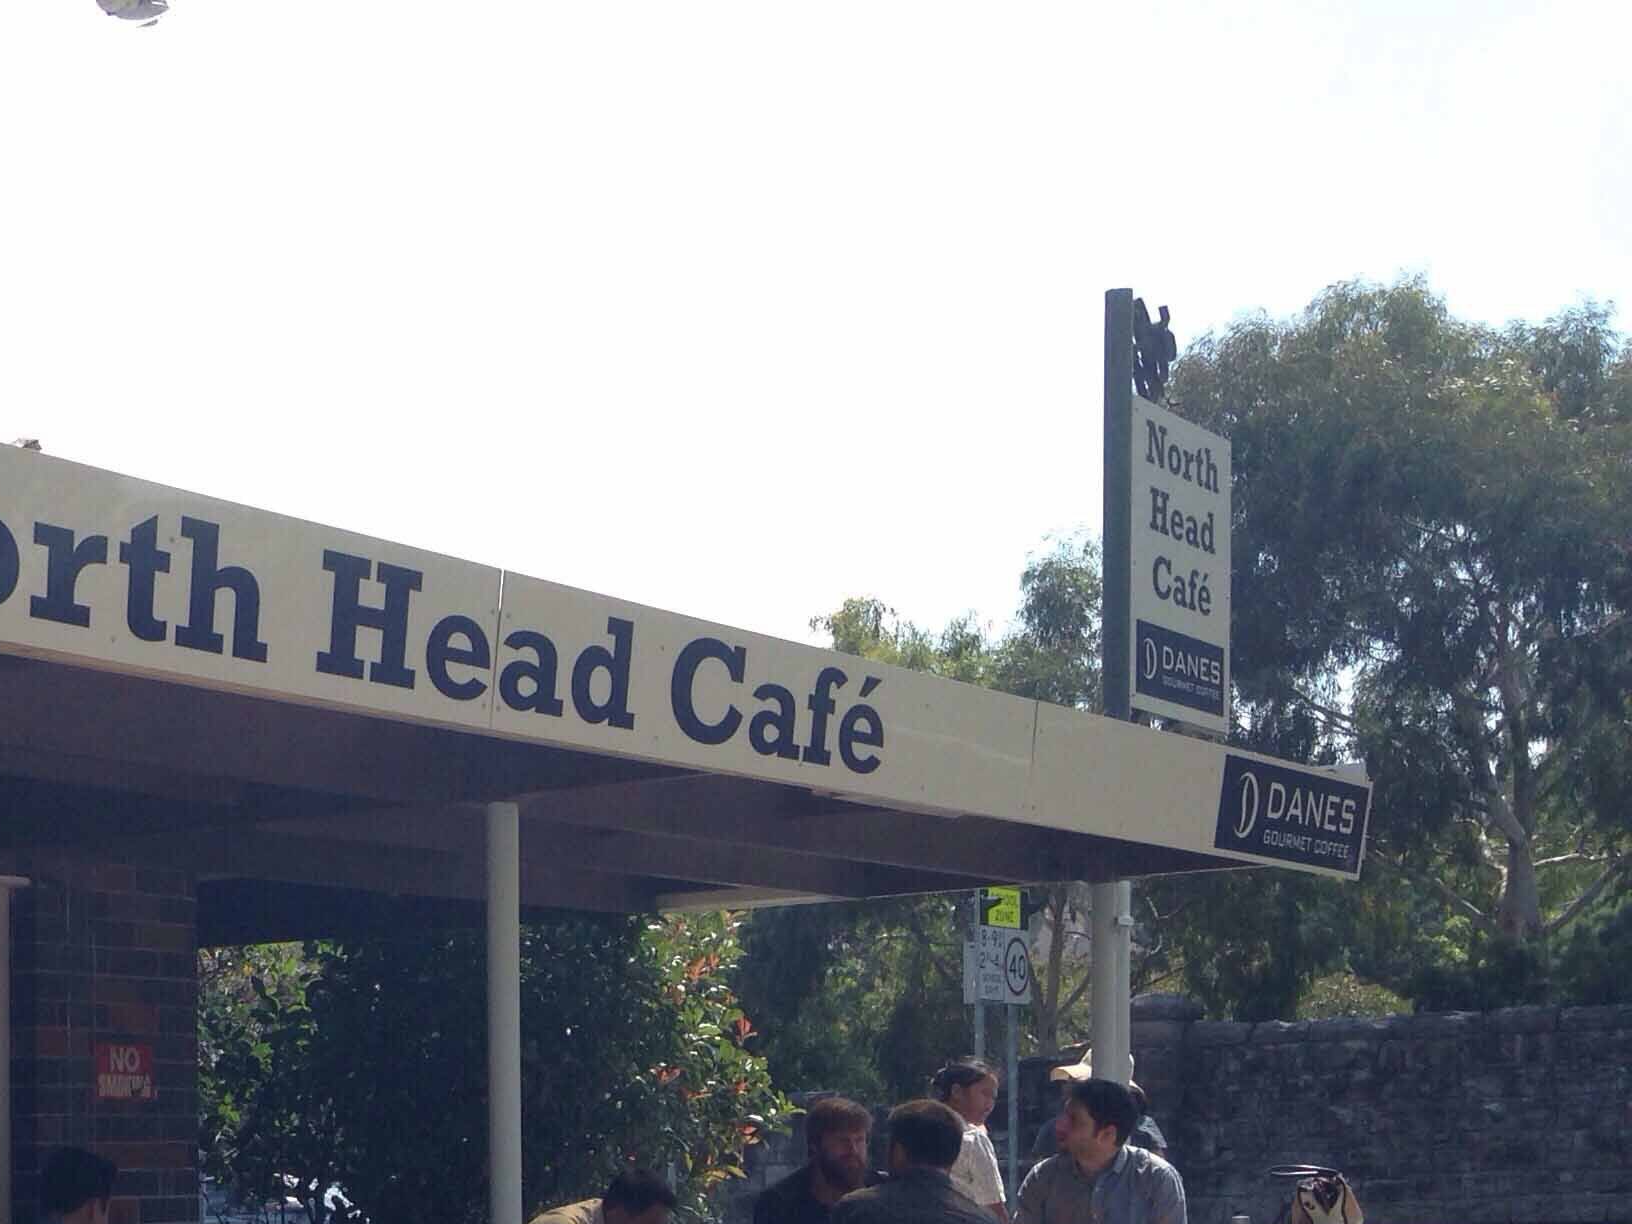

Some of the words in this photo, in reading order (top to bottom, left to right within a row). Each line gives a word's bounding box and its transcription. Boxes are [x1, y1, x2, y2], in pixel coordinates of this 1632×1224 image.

[1145, 419, 1219, 494] North
[1149, 487, 1215, 555] Head
[1152, 555, 1212, 616] Café
[315, 549, 635, 730] Head
[670, 637, 885, 775] Café
[1162, 646, 1221, 685] DANES
[1266, 782, 1356, 835] DANES
[1263, 829, 1312, 852] GOURMET
[1314, 838, 1352, 859] COFFEE
[1009, 954, 1026, 980] 40
[110, 1046, 141, 1073] NO
